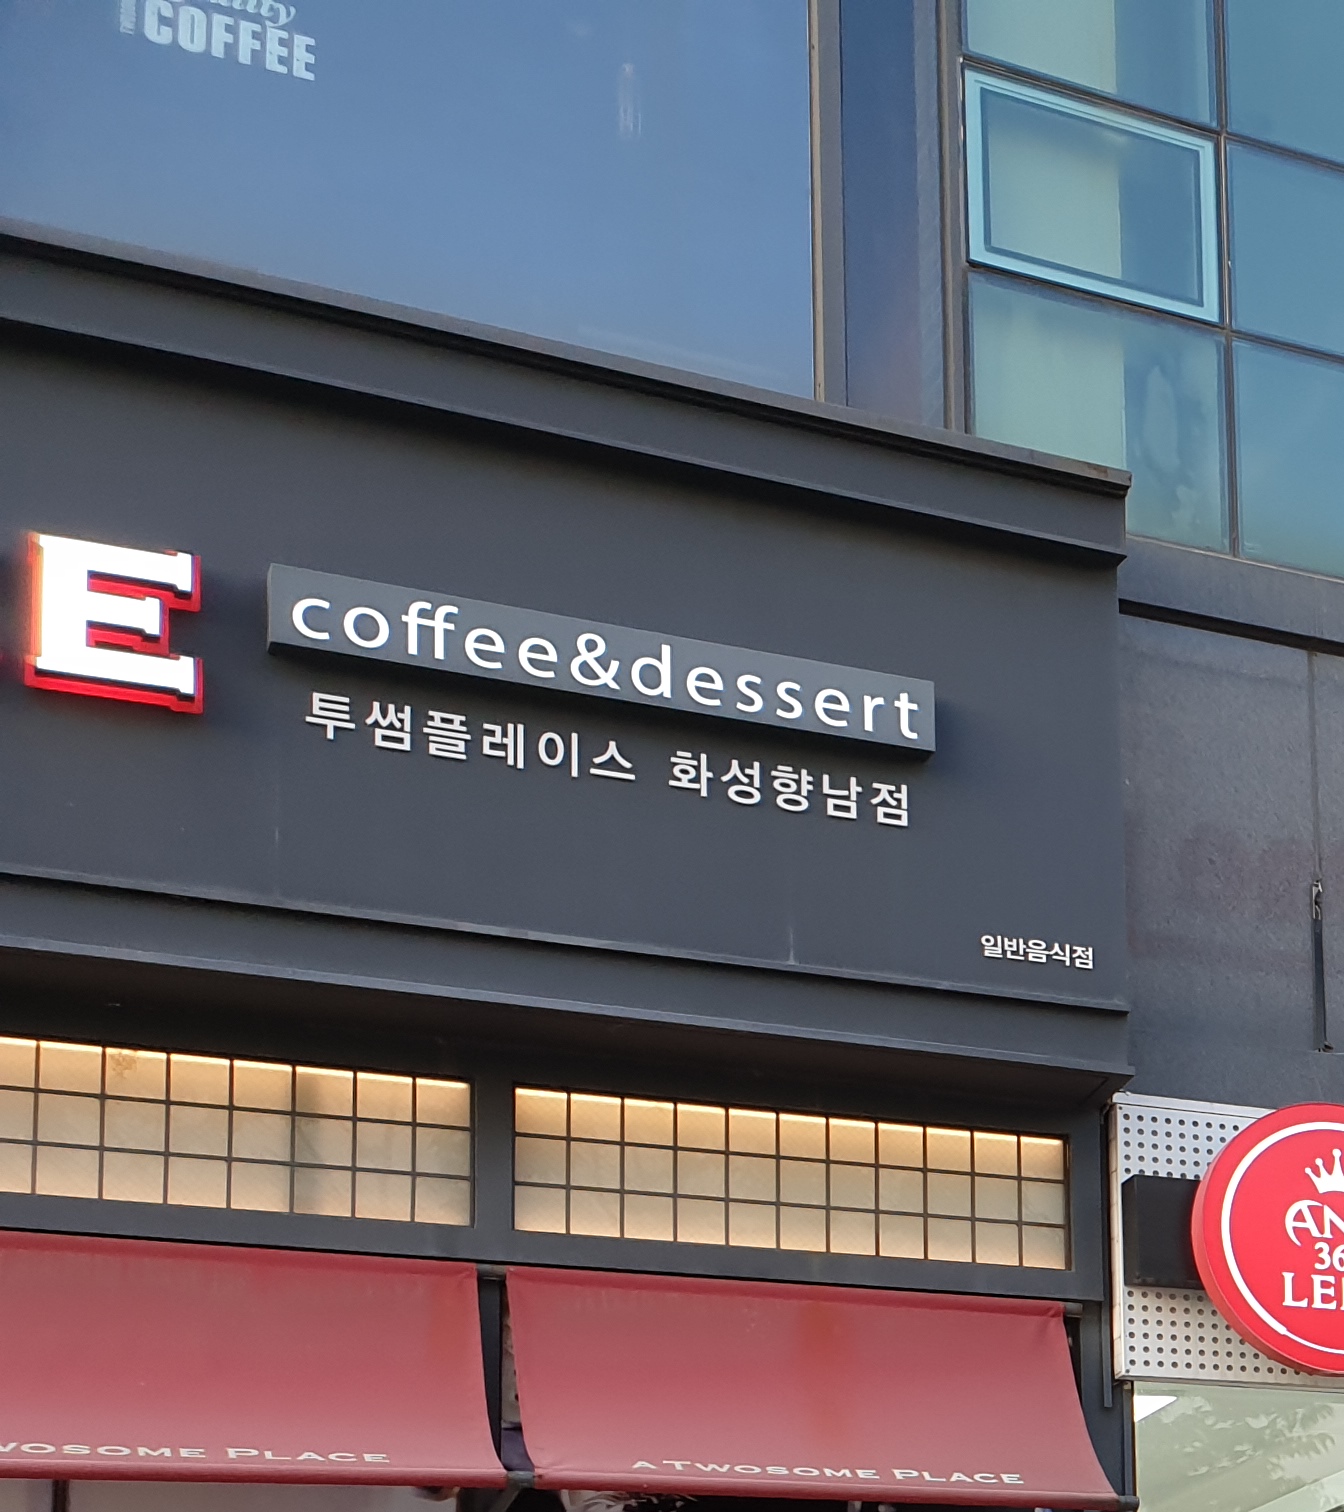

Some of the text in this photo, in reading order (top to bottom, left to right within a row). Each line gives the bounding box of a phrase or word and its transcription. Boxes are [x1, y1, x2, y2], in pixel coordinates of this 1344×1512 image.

[143, 0, 316, 81] COFFEE
[291, 595, 920, 742] coffee&dessert
[304, 690, 912, 829] 투썸플레이스 화성향남점
[979, 933, 1095, 970] 일반음식점
[226, 1446, 391, 1463] PLACE
[631, 1459, 1026, 1486] A TWOSOME PLACE
